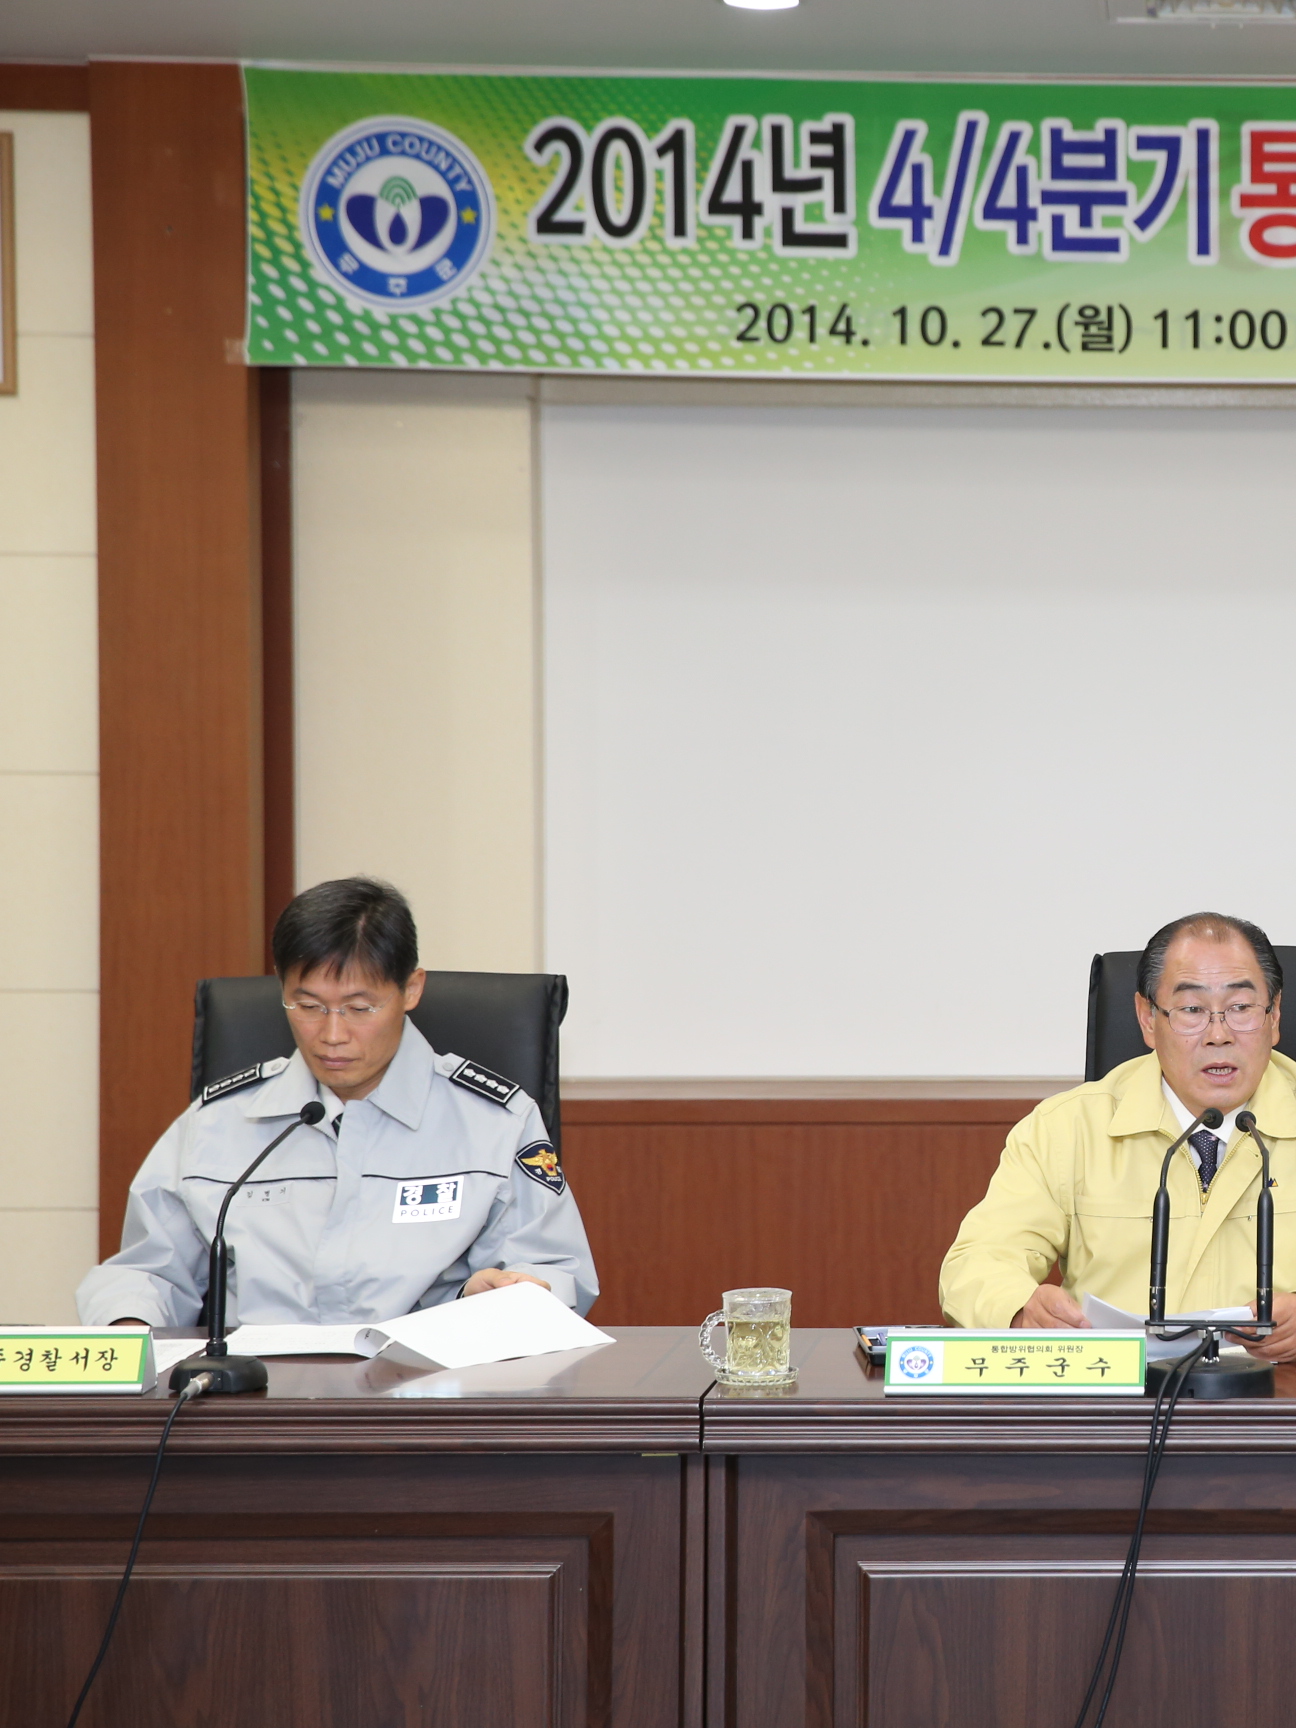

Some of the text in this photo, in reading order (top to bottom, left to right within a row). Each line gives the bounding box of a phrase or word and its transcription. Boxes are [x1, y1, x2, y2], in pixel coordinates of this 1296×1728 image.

[325, 133, 473, 192] MUJU COUNTY
[531, 120, 850, 250] 2014년
[875, 117, 1213, 259] 4/4분기
[735, 301, 872, 348] 2014.
[891, 304, 962, 349] 10.
[980, 302, 1133, 355] 27.(월)
[1153, 308, 1288, 351] 11:00
[400, 1206, 454, 1217] POLICE
[402, 1182, 457, 1205] 경찰
